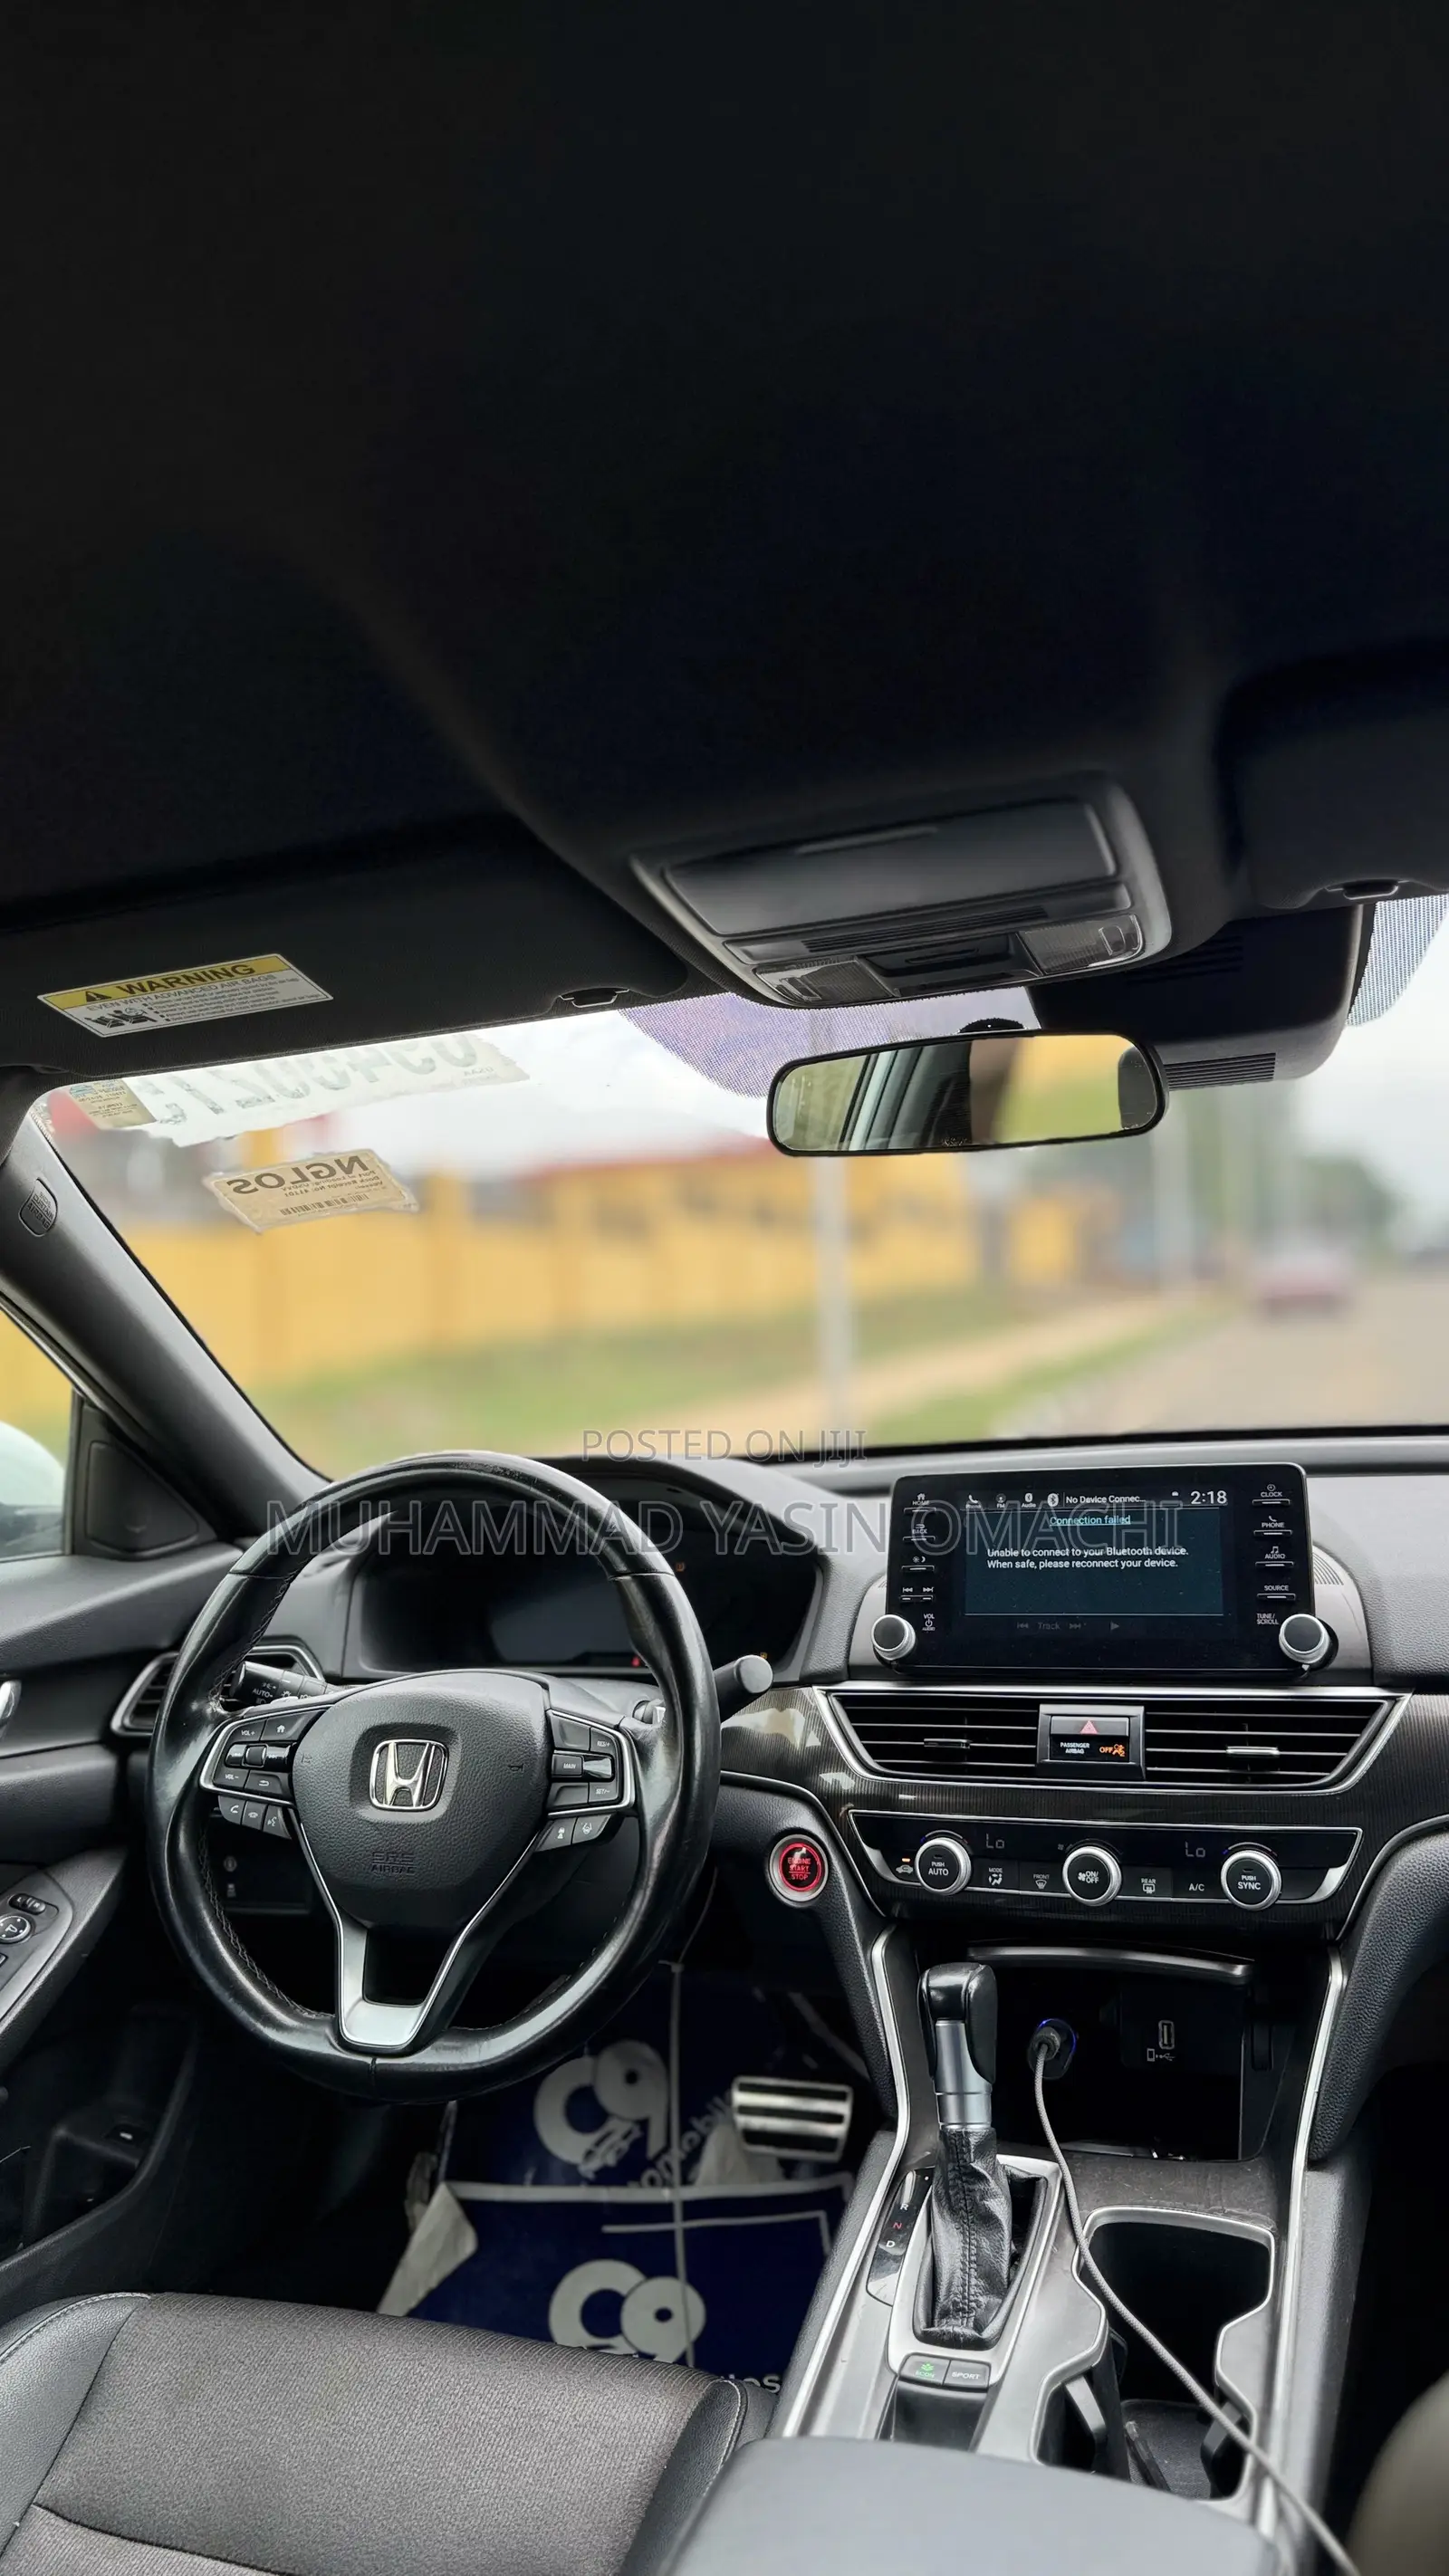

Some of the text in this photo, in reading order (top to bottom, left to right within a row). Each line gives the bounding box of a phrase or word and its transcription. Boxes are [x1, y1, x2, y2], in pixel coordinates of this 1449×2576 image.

[116, 964, 255, 996] WARNING
[86, 974, 276, 1012] EVEN WITH ADVANCED AIR BAGS
[1065, 1496, 1078, 1504] No
[1080, 1496, 1106, 1504] Device
[1190, 1490, 1228, 1505] 2:18
[1050, 1515, 1131, 1525] Connection failed
[987, 1548, 1019, 1557] Unable
[1032, 1548, 1069, 1556] connect
[1071, 1548, 1081, 1556] to
[1083, 1549, 1104, 1557] your
[1106, 1547, 1153, 1556] Bluetooth
[1155, 1547, 1189, 1556] device.
[987, 1558, 1178, 1570] When safe, please reconnect your device.
[1038, 1622, 1060, 1630] Track
[253, 1687, 271, 1699] AUTO
[787, 1857, 811, 1865] ENGINE
[927, 1867, 949, 1876] AUTO
[1188, 1882, 1205, 1891] A/C
[1237, 1882, 1262, 1891] SYNC
[899, 2202, 908, 2211] R
[892, 2221, 902, 2230] N
[886, 2240, 896, 2248] D
[916, 2370, 936, 2379] ECON
[951, 2370, 981, 2380] SPORT
